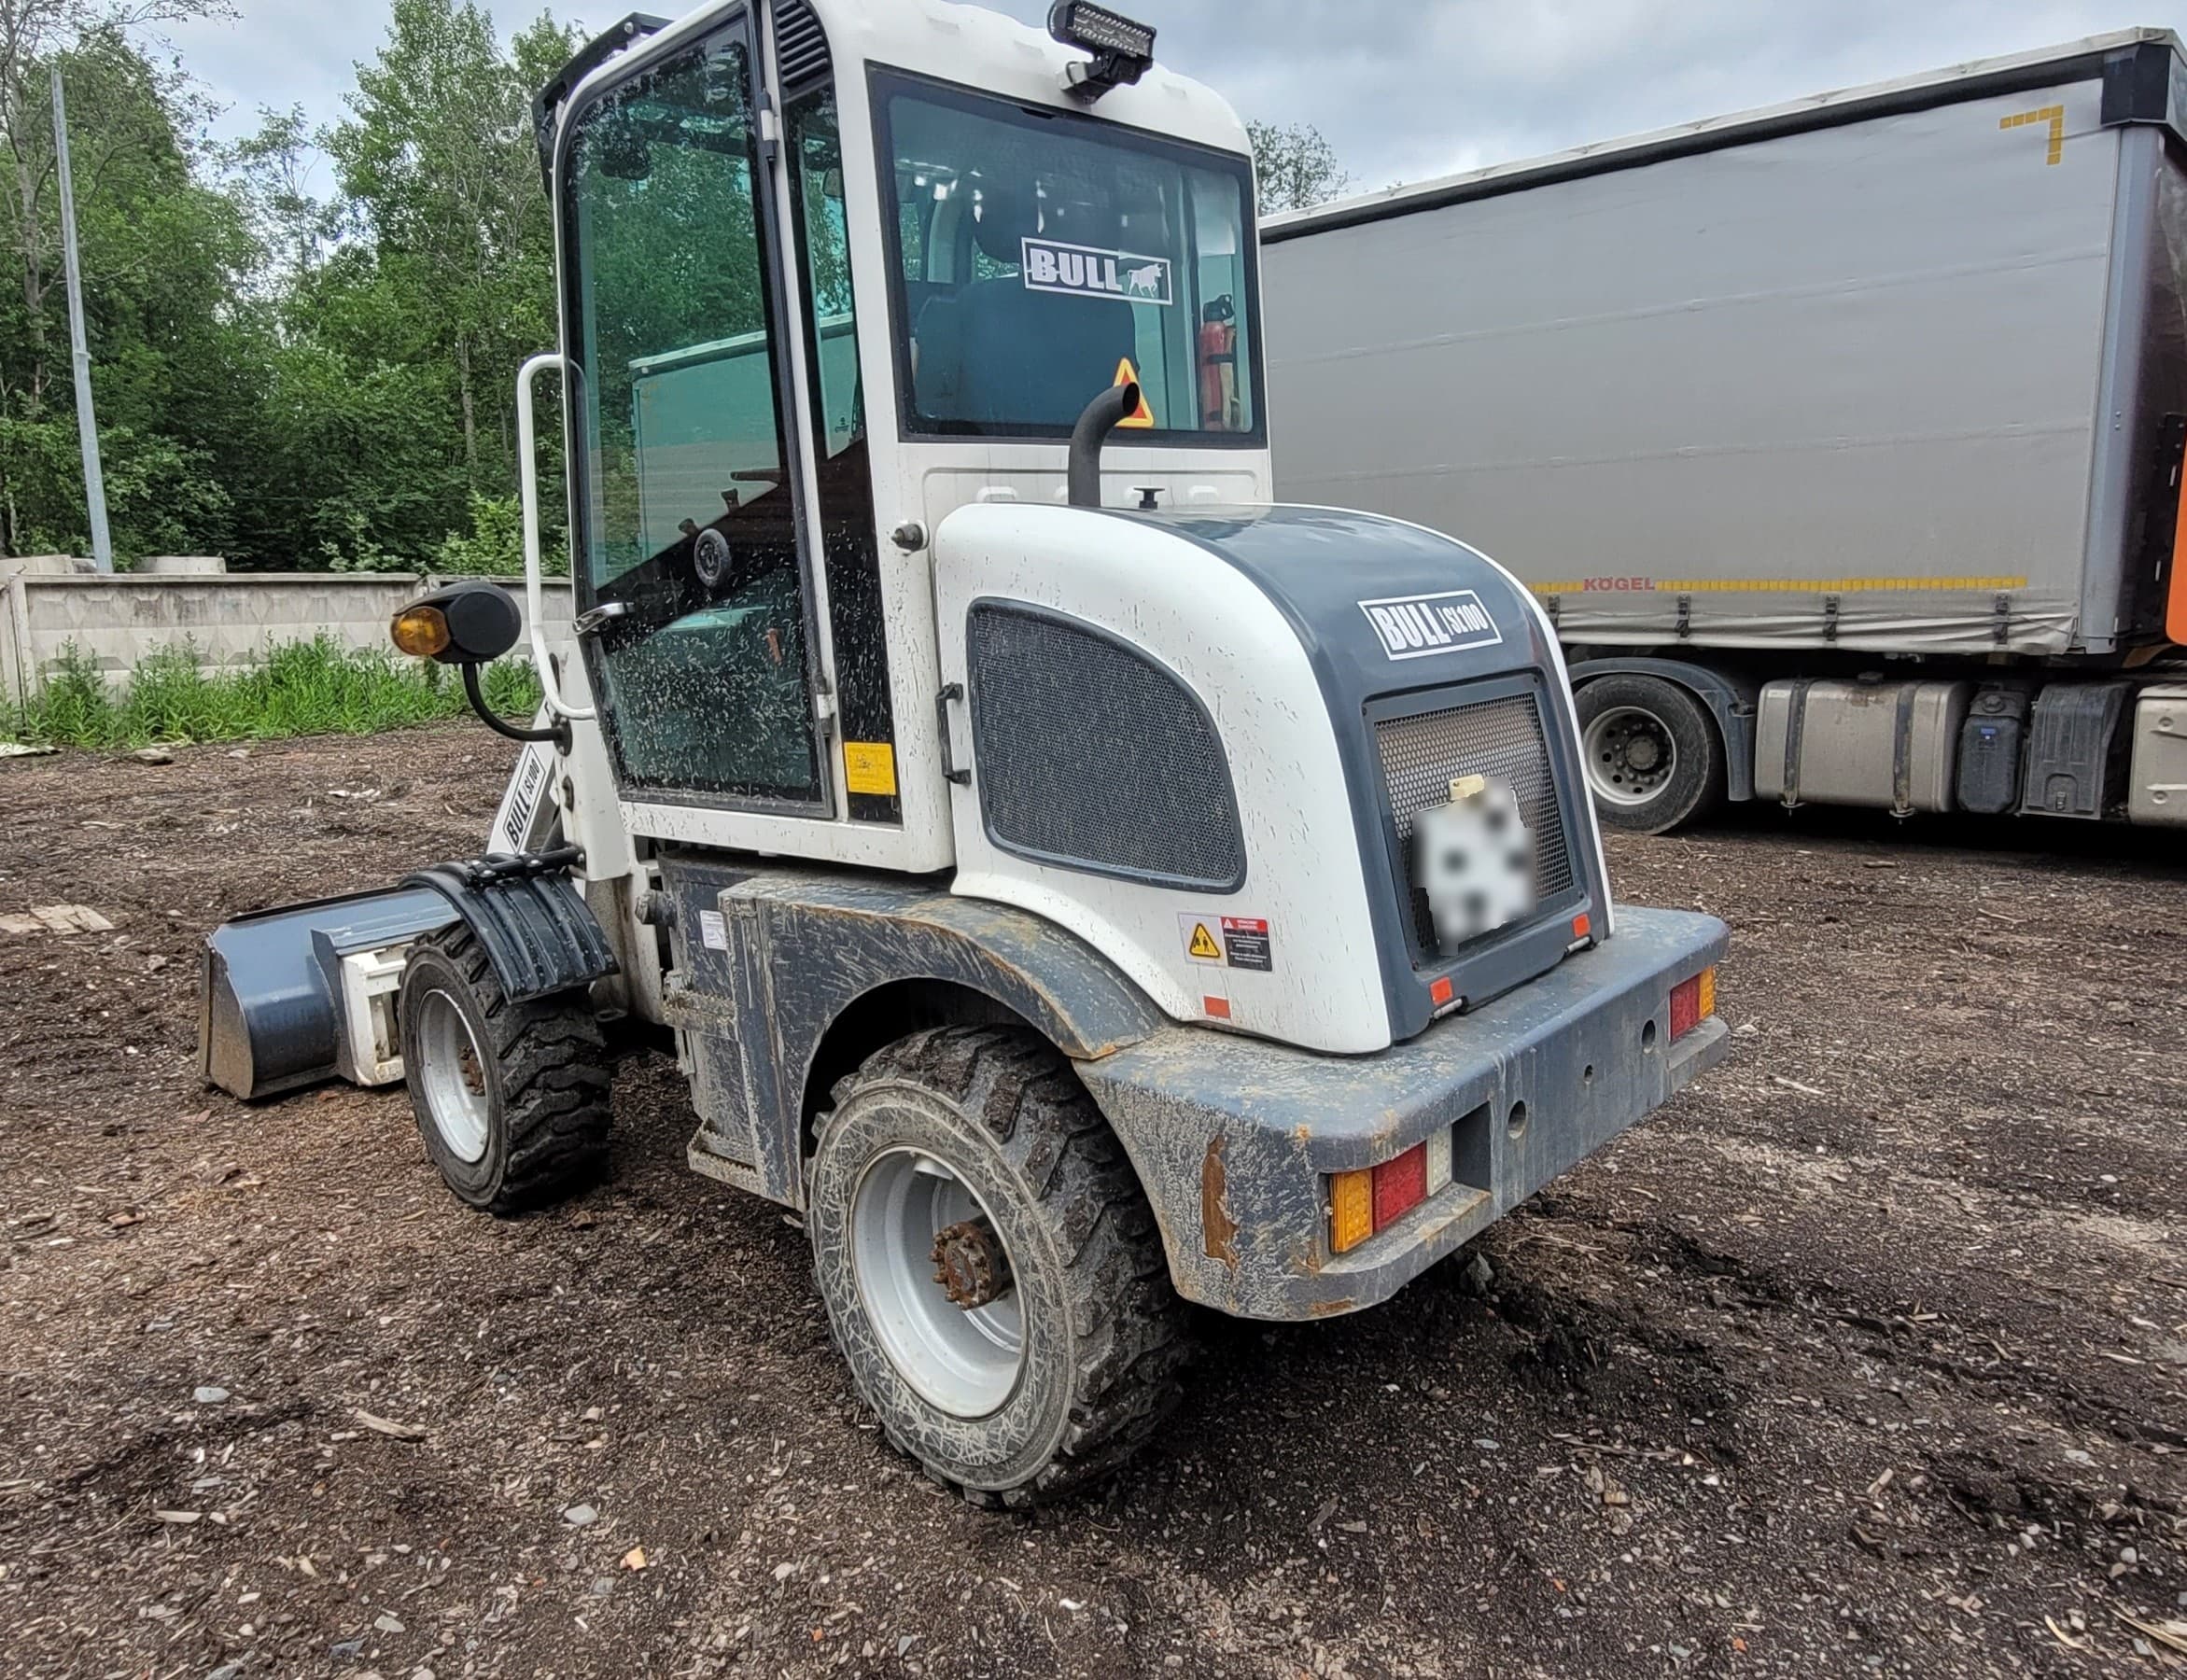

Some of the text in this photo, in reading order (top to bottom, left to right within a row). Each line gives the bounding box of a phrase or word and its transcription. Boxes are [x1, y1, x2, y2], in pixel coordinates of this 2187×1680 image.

[1030, 247, 1123, 292] BULL
[1582, 576, 1656, 592] KÖGEL
[1369, 602, 1452, 651] BULL
[506, 790, 531, 848] BULL
